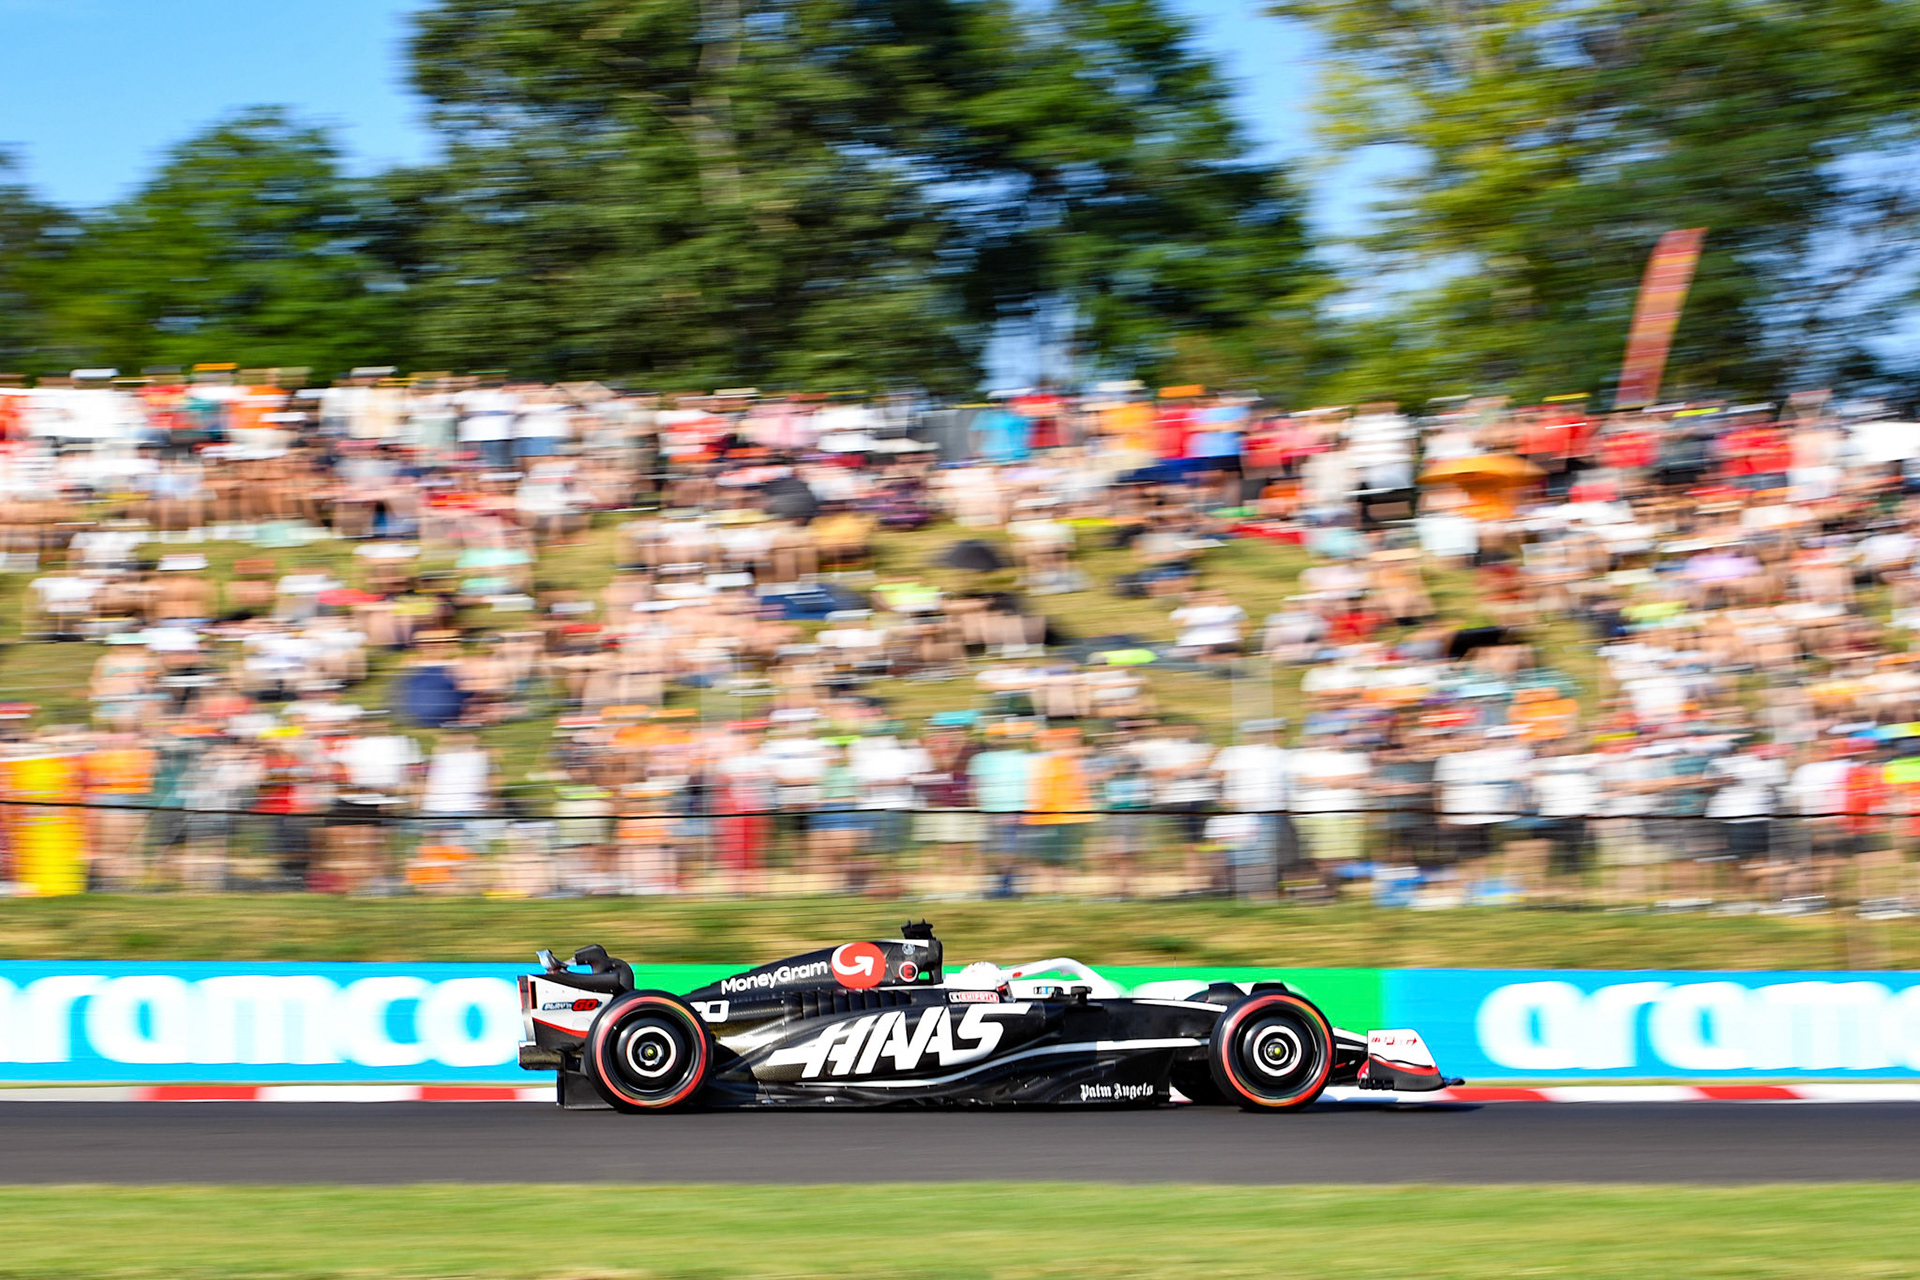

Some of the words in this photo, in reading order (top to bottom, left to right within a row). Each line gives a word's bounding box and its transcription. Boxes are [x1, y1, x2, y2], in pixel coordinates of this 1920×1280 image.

[720, 960, 828, 995] MoneyGram
[0, 974, 523, 1067] ramco
[572, 999, 599, 1011] GO
[765, 1002, 1032, 1079] HAAS
[1080, 1083, 1112, 1102] Palm
[1113, 1082, 1154, 1100] Angels
